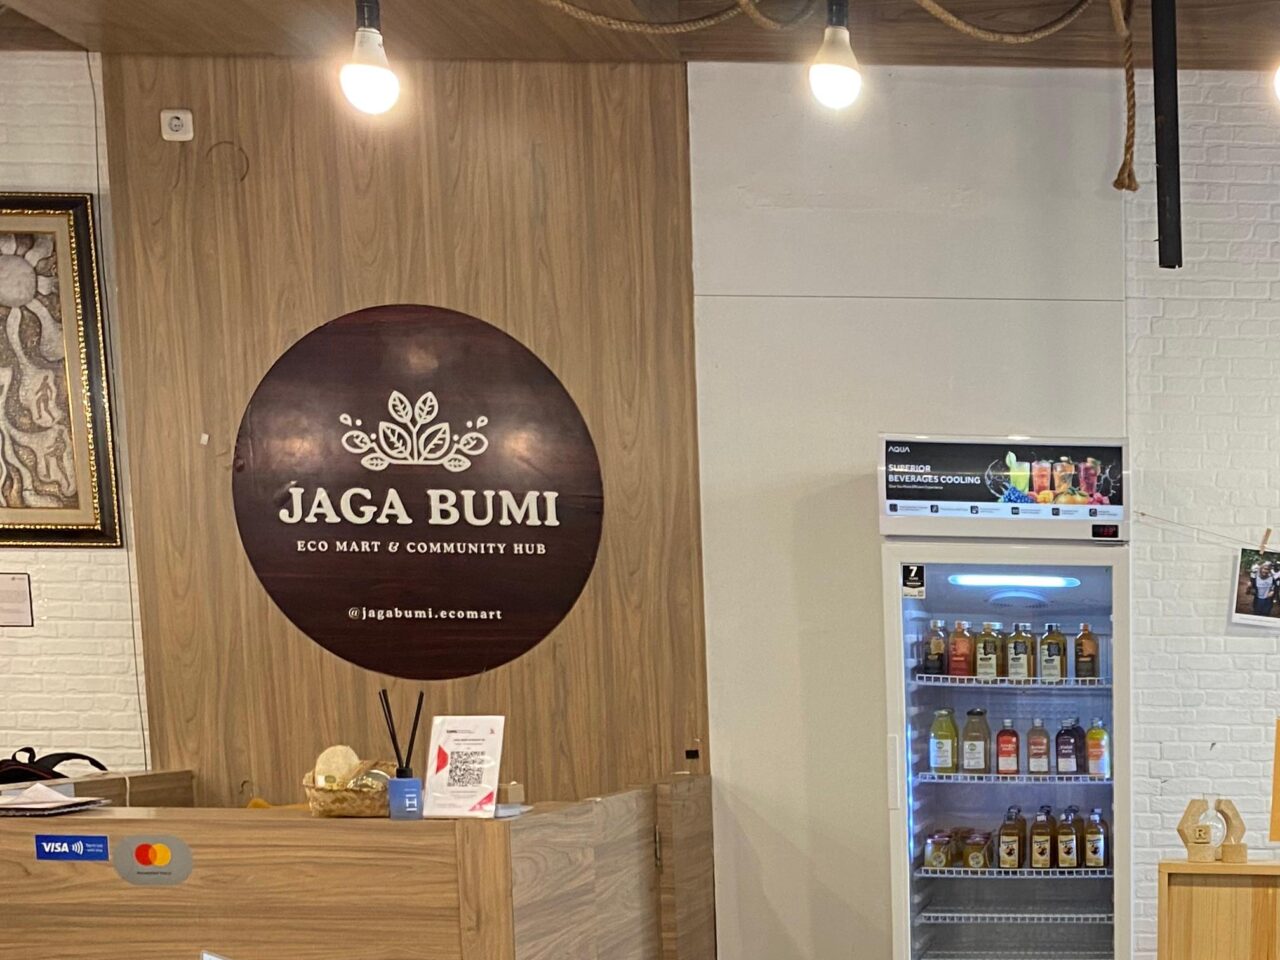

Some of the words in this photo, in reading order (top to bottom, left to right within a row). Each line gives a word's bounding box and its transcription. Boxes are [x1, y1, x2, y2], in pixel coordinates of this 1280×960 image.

[888, 464, 931, 472] SUPERIOR
[888, 474, 939, 483] BEVERAGES
[940, 476, 981, 484] COOLING
[279, 487, 413, 525] JAGA
[427, 488, 560, 527] BUMI
[297, 541, 328, 552] ECO
[336, 541, 381, 553] MART
[388, 542, 400, 553] &
[406, 542, 507, 555] COMMUNITY
[513, 543, 547, 555] HUB
[909, 566, 918, 577] 7
[348, 607, 503, 622] @jagabumi.ecomart
[41, 842, 70, 853] VISA
